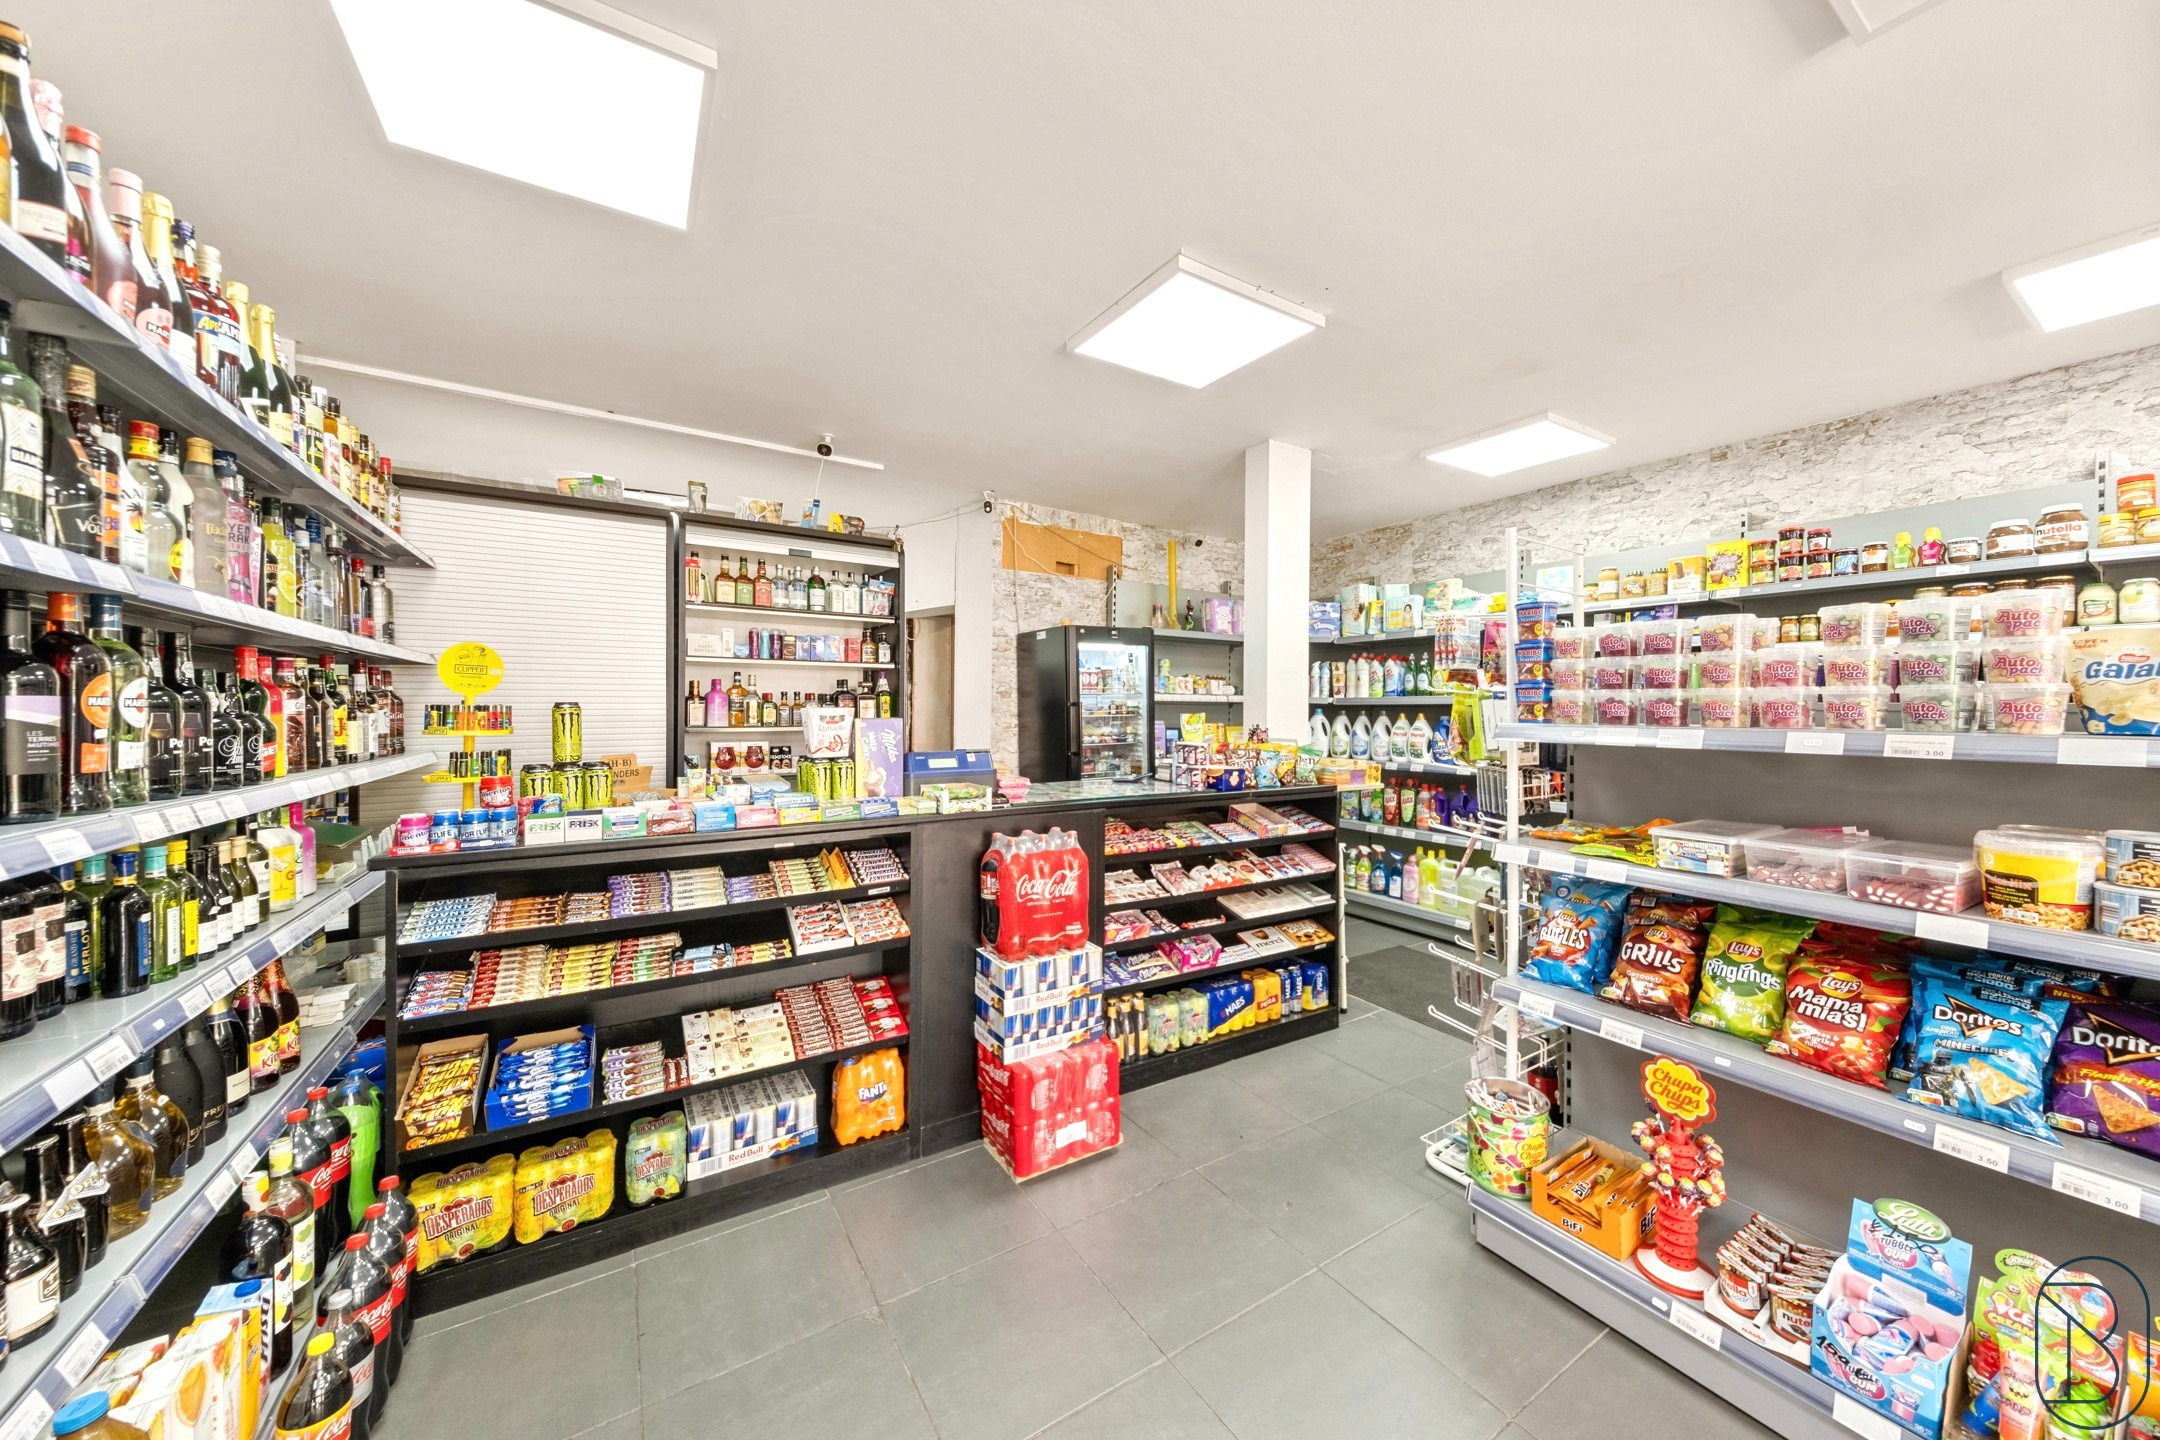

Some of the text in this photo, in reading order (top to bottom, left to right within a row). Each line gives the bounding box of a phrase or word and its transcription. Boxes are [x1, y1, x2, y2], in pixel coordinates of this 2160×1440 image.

[2036, 521, 2083, 537] nutella
[1997, 609, 2042, 623] Auto
[1313, 621, 1336, 631] Kleenex
[1903, 624, 1935, 636] pack
[1606, 642, 1627, 651] pack
[1650, 640, 1673, 650] pack
[1764, 663, 1792, 674] Auto
[1829, 662, 1860, 673] Auto
[1902, 660, 1931, 672] Auto
[1993, 656, 2037, 669] Auto
[456, 666, 485, 674] CLIPPER
[1648, 669, 1672, 678] Auto
[1702, 666, 1726, 676] Auto
[1773, 671, 1800, 681] pack
[1909, 666, 1944, 678] pack
[2006, 664, 2046, 677] pack
[1709, 673, 1733, 682] pack
[1838, 671, 1869, 682] pack
[1518, 689, 1543, 697] HARIBO
[1601, 702, 1623, 711] Auto
[1649, 701, 1672, 711] Auto
[1703, 702, 1729, 711] Auto
[1764, 701, 1792, 712] Auto
[1827, 702, 1856, 713] Auto
[1904, 702, 1937, 713] Auto
[2000, 701, 2044, 714] Auto
[1561, 708, 1580, 717] pack
[1607, 709, 1629, 718] pack
[1656, 709, 1679, 718] pack
[1712, 709, 1736, 719] pack
[1773, 709, 1800, 719] pack
[1835, 711, 1865, 720] pack
[1912, 709, 1948, 721] pack
[27, 730, 44, 738] LES
[818, 724, 847, 733] Raffaello
[880, 729, 896, 764] Milka
[481, 786, 511, 799] mentos
[528, 822, 562, 833] FRISK
[569, 818, 600, 829] FRISK
[873, 874, 900, 882] SNICKERS
[1558, 912, 1579, 924] Lay's
[1539, 928, 1588, 950] BUGLES
[1646, 927, 1669, 940] Lay's
[1256, 936, 1284, 949] merci
[81, 928, 91, 975] MERLOT
[1729, 941, 1762, 957] Lay's
[1621, 941, 1686, 974] GRILLS
[1822, 975, 1861, 992] Lay's
[1036, 991, 1063, 1003] Red Bull
[1789, 985, 1863, 1014] Mama
[2053, 989, 2084, 1000] NEW
[1225, 997, 1246, 1016] MAES
[1934, 1004, 2024, 1036] Doritos
[1036, 1038, 1063, 1050] Red Bull
[1652, 1066, 1702, 1096] Chupa
[858, 1080, 888, 1103] FANTA
[1649, 1079, 1701, 1111] Chups
[1521, 1140, 1544, 1152] Chupa
[728, 1145, 764, 1163] Red Bull
[1519, 1150, 1544, 1164] Chups
[636, 1154, 675, 1179] DESPERADOS
[1977, 1154, 1998, 1168] 3.50
[534, 1174, 595, 1215] DESPERADOS
[549, 1199, 581, 1217] ORIGINAL
[2104, 1196, 2129, 1211] 3.00
[424, 1197, 493, 1241] DESPERADOS
[1877, 1202, 1940, 1237] Lutti
[1562, 1217, 1584, 1234] BiFi
[444, 1222, 479, 1242] ORIGINAL
[1884, 1247, 1911, 1262] GUM
[1741, 1327, 1766, 1343] nutella
[1849, 1375, 1877, 1394] GUM
